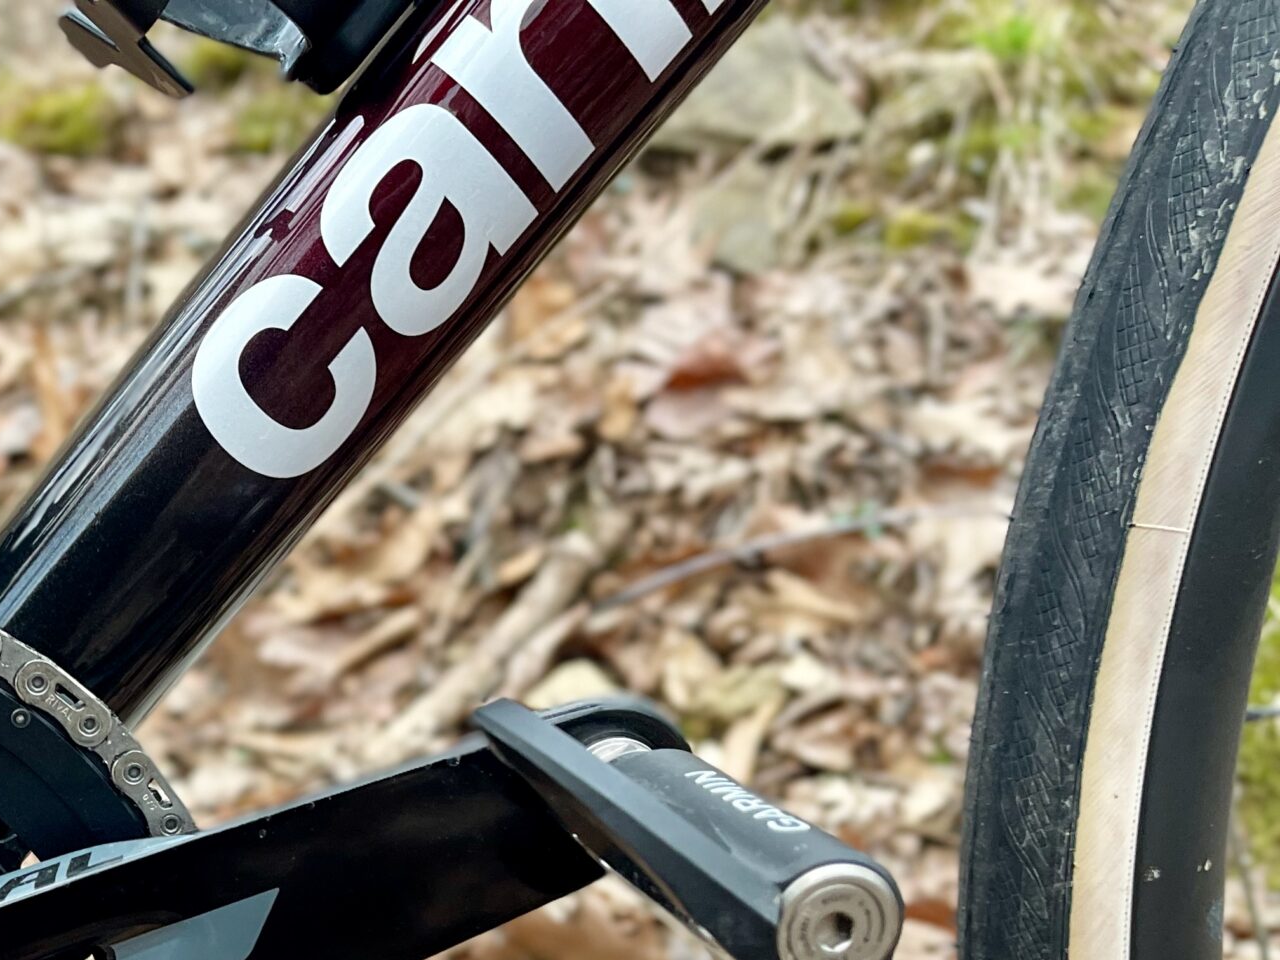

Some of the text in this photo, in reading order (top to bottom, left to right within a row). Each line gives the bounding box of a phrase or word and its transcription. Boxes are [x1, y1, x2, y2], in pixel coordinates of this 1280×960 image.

[191, 0, 720, 479] can
[44, 694, 74, 722] RIVAL
[683, 770, 811, 832] GARMIN
